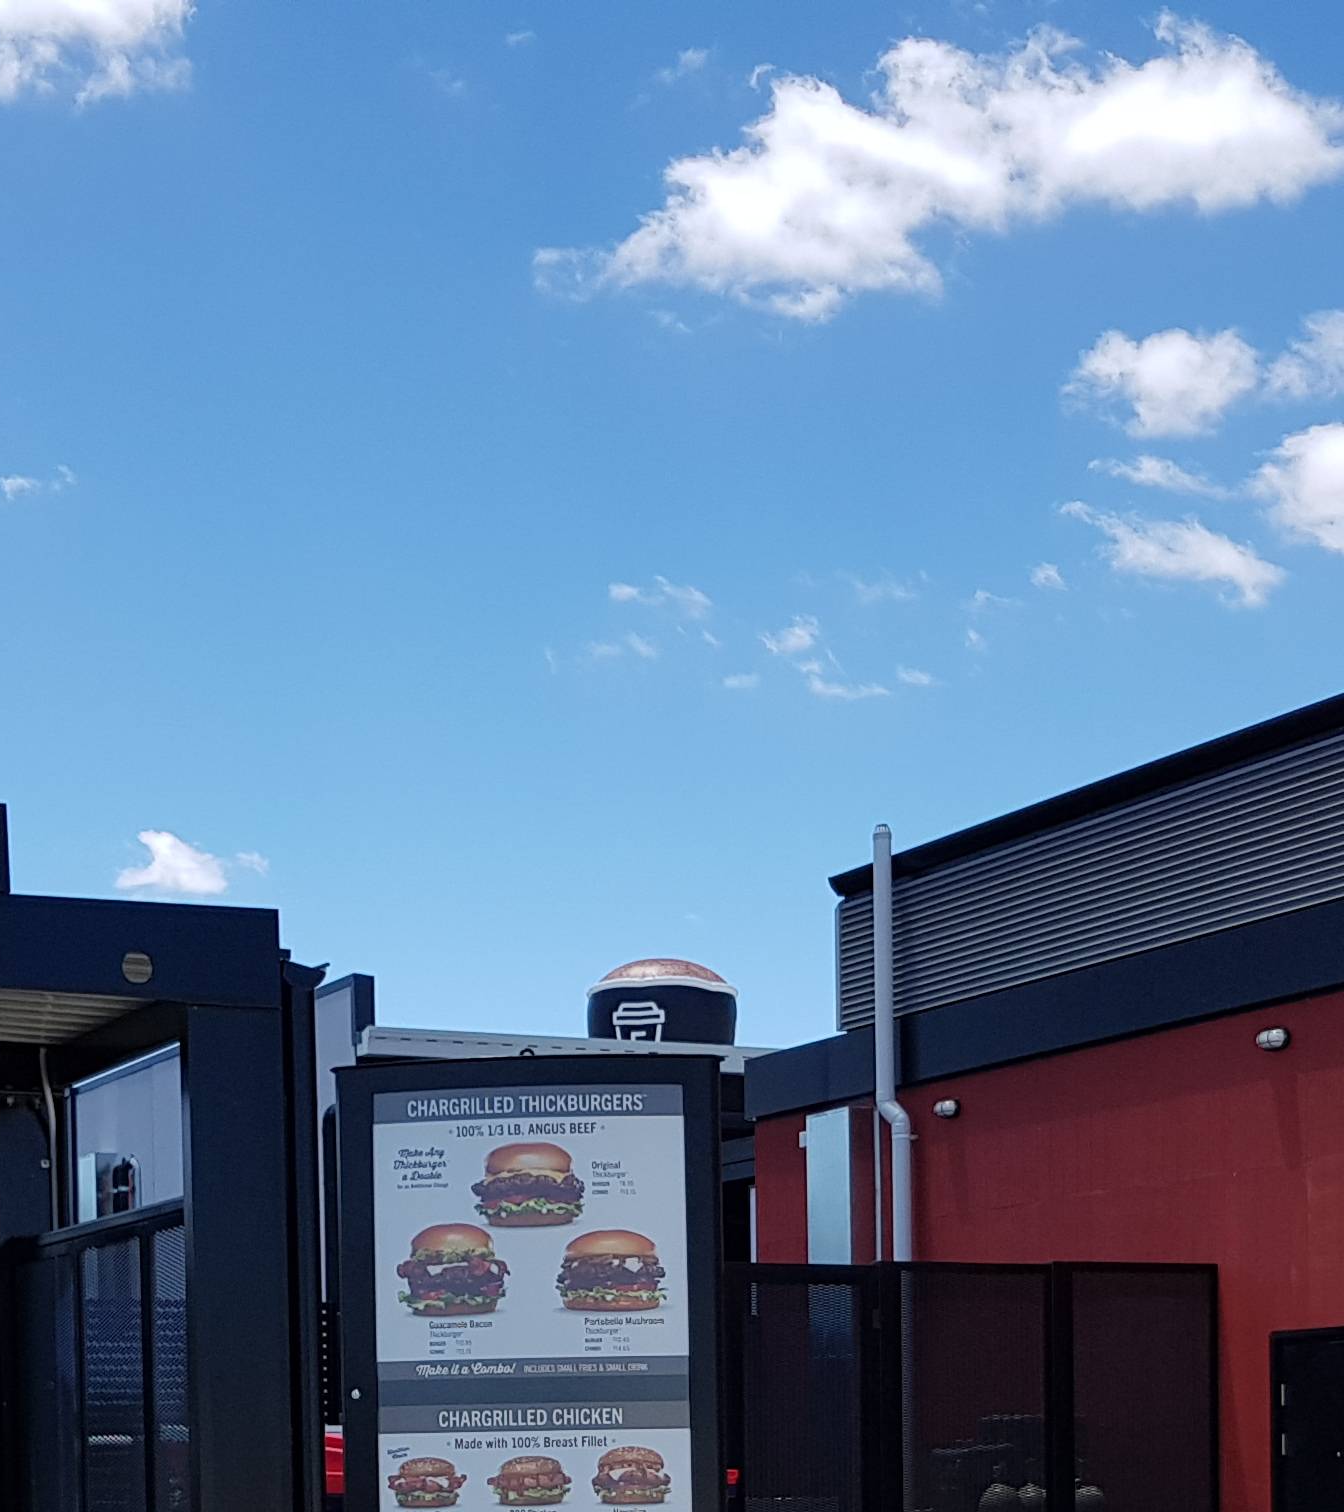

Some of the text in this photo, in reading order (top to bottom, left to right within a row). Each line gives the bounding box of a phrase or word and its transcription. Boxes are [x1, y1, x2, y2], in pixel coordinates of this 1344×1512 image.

[407, 1094, 644, 1118] CHARGRILLED THICKBURGERS
[456, 1125, 484, 1137] 100%
[488, 1125, 504, 1136] 1/3
[528, 1122, 566, 1135] ANGUS
[569, 1121, 597, 1134] BEEF
[591, 1161, 621, 1171] Original
[416, 1364, 449, 1378] Make
[450, 1363, 460, 1375] it
[461, 1366, 469, 1375] a
[471, 1362, 516, 1375] Combo!
[438, 1407, 623, 1428] CHARGRILLED CHICKEN
[454, 1435, 608, 1449] Made with 100% Breast Fillet
